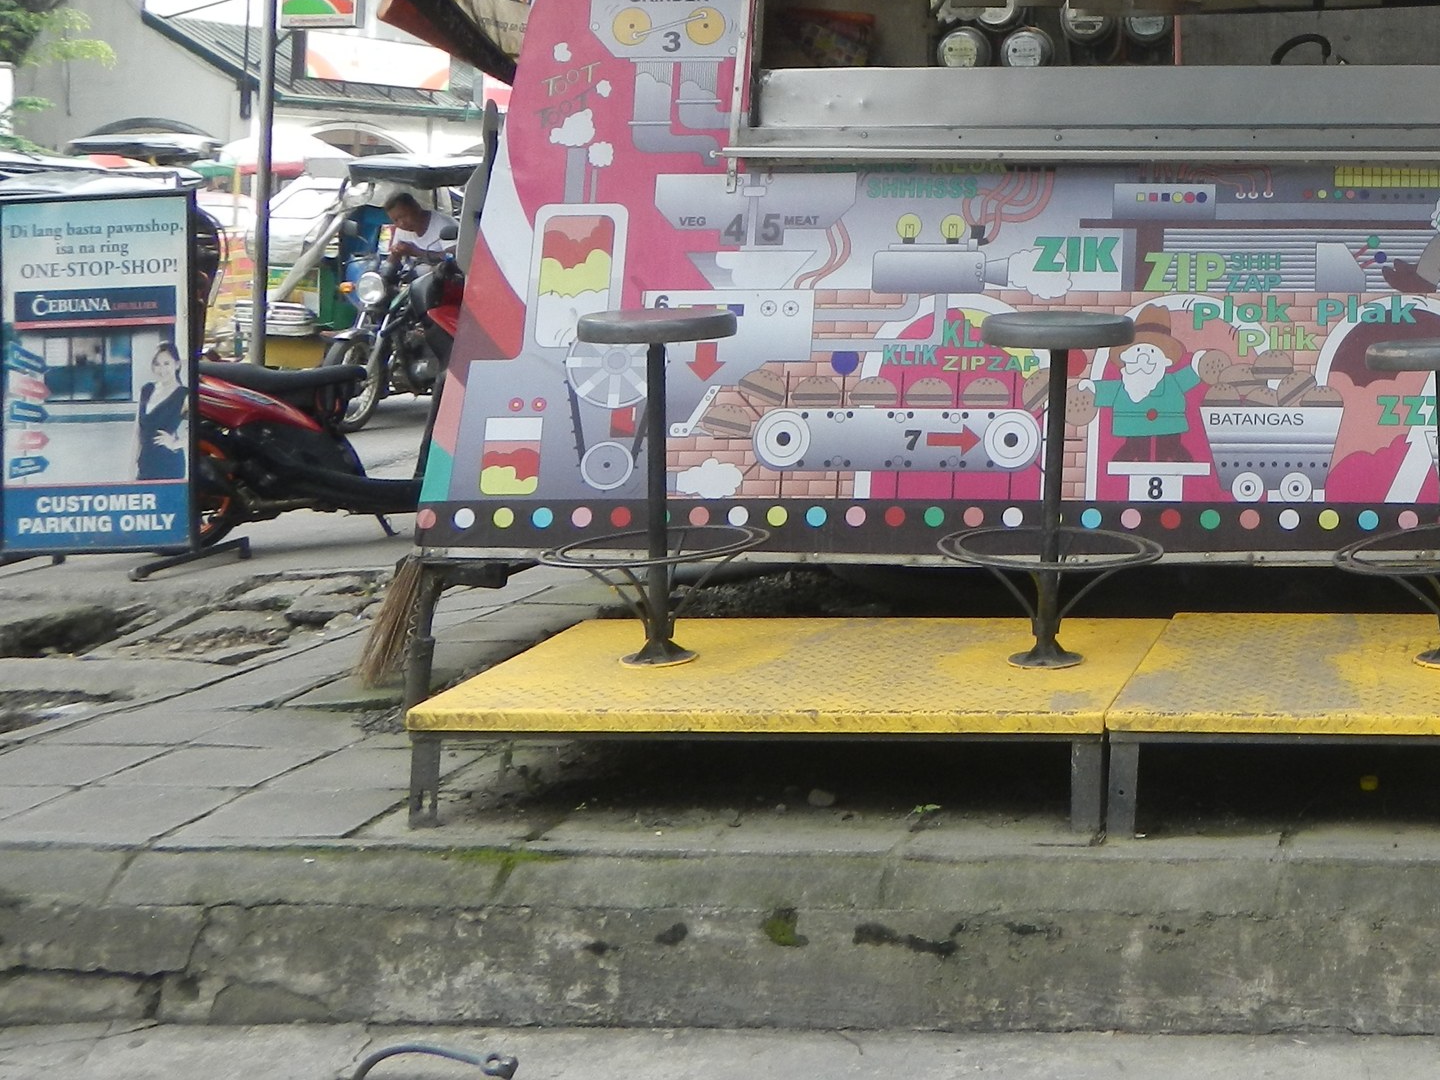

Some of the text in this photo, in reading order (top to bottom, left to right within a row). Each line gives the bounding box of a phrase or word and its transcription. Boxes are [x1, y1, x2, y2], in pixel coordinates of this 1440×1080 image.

[662, 32, 681, 53] 3
[32, 224, 62, 241] lang
[67, 223, 103, 236] basta
[679, 213, 819, 242] VEG 4 5 MEAT
[56, 240, 129, 257] isa na ring
[1032, 236, 1120, 272] ZIK
[21, 257, 178, 280] ONE-STOP-SHOP!
[1143, 252, 1282, 293] ZIP SHH
[1226, 273, 1282, 293] ZAP
[882, 343, 940, 366] KLIK
[1209, 412, 1305, 426] BATANGAS
[904, 429, 923, 451] 7
[1148, 476, 1163, 500] 8
[36, 493, 157, 513] CUSTOMER
[18, 513, 175, 534] PARKING ONLY
